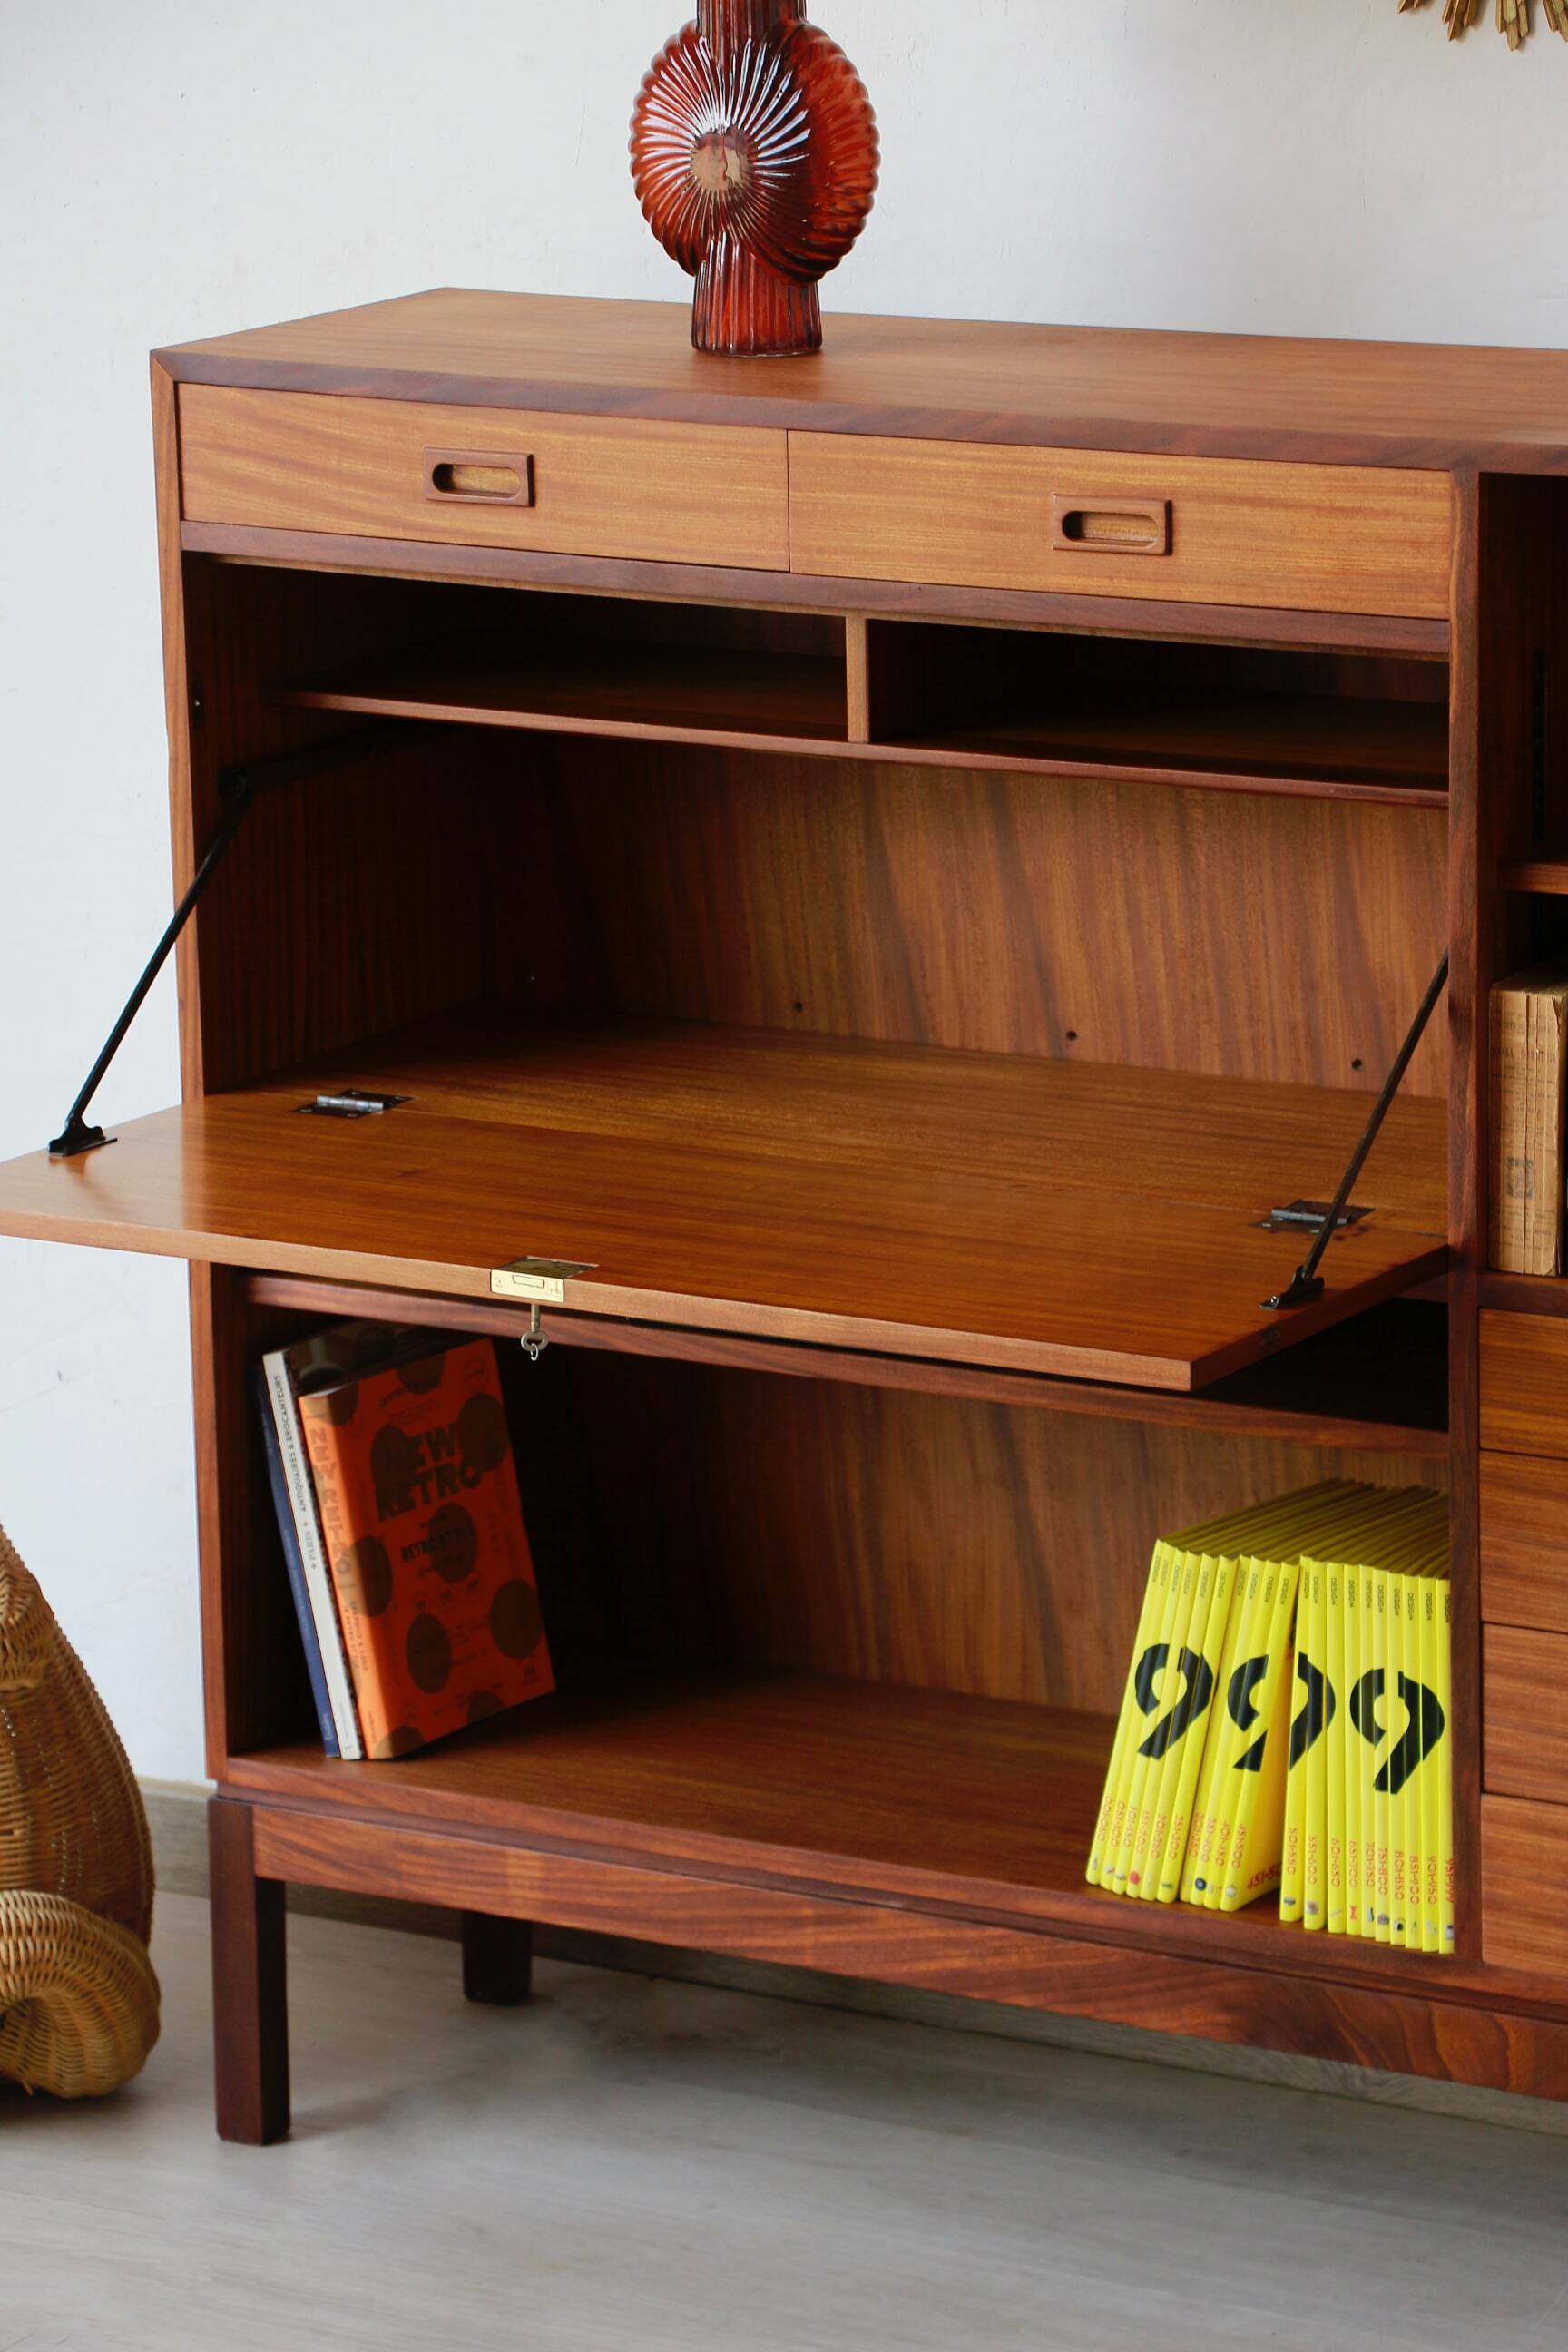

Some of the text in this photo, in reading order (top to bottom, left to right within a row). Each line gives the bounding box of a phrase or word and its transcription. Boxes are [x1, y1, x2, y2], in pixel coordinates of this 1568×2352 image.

[273, 1375, 293, 1441] BROCANTEURS
[288, 1451, 306, 1512] ANTIQUAIRES
[1124, 1807, 1137, 1847] 101-150
[1151, 1815, 1167, 1858] 201-250
[1168, 1815, 1184, 1858] 251-300
[1201, 1816, 1217, 1863] 351-400
[1217, 1821, 1230, 1866] 401-450
[1232, 1823, 1246, 1868] 451-500
[1288, 1828, 1298, 1875] 501-550
[1308, 1836, 1317, 1884] 551-600
[1331, 1838, 1340, 1886] 601-650
[1349, 1839, 1358, 1887] 651-700
[1366, 1842, 1375, 1887] 701-750
[1378, 1847, 1387, 1895] 751-800
[1395, 1851, 1404, 1901] 801-850
[1409, 1855, 1419, 1905] 851-900
[1427, 1856, 1437, 1904] 901-950
